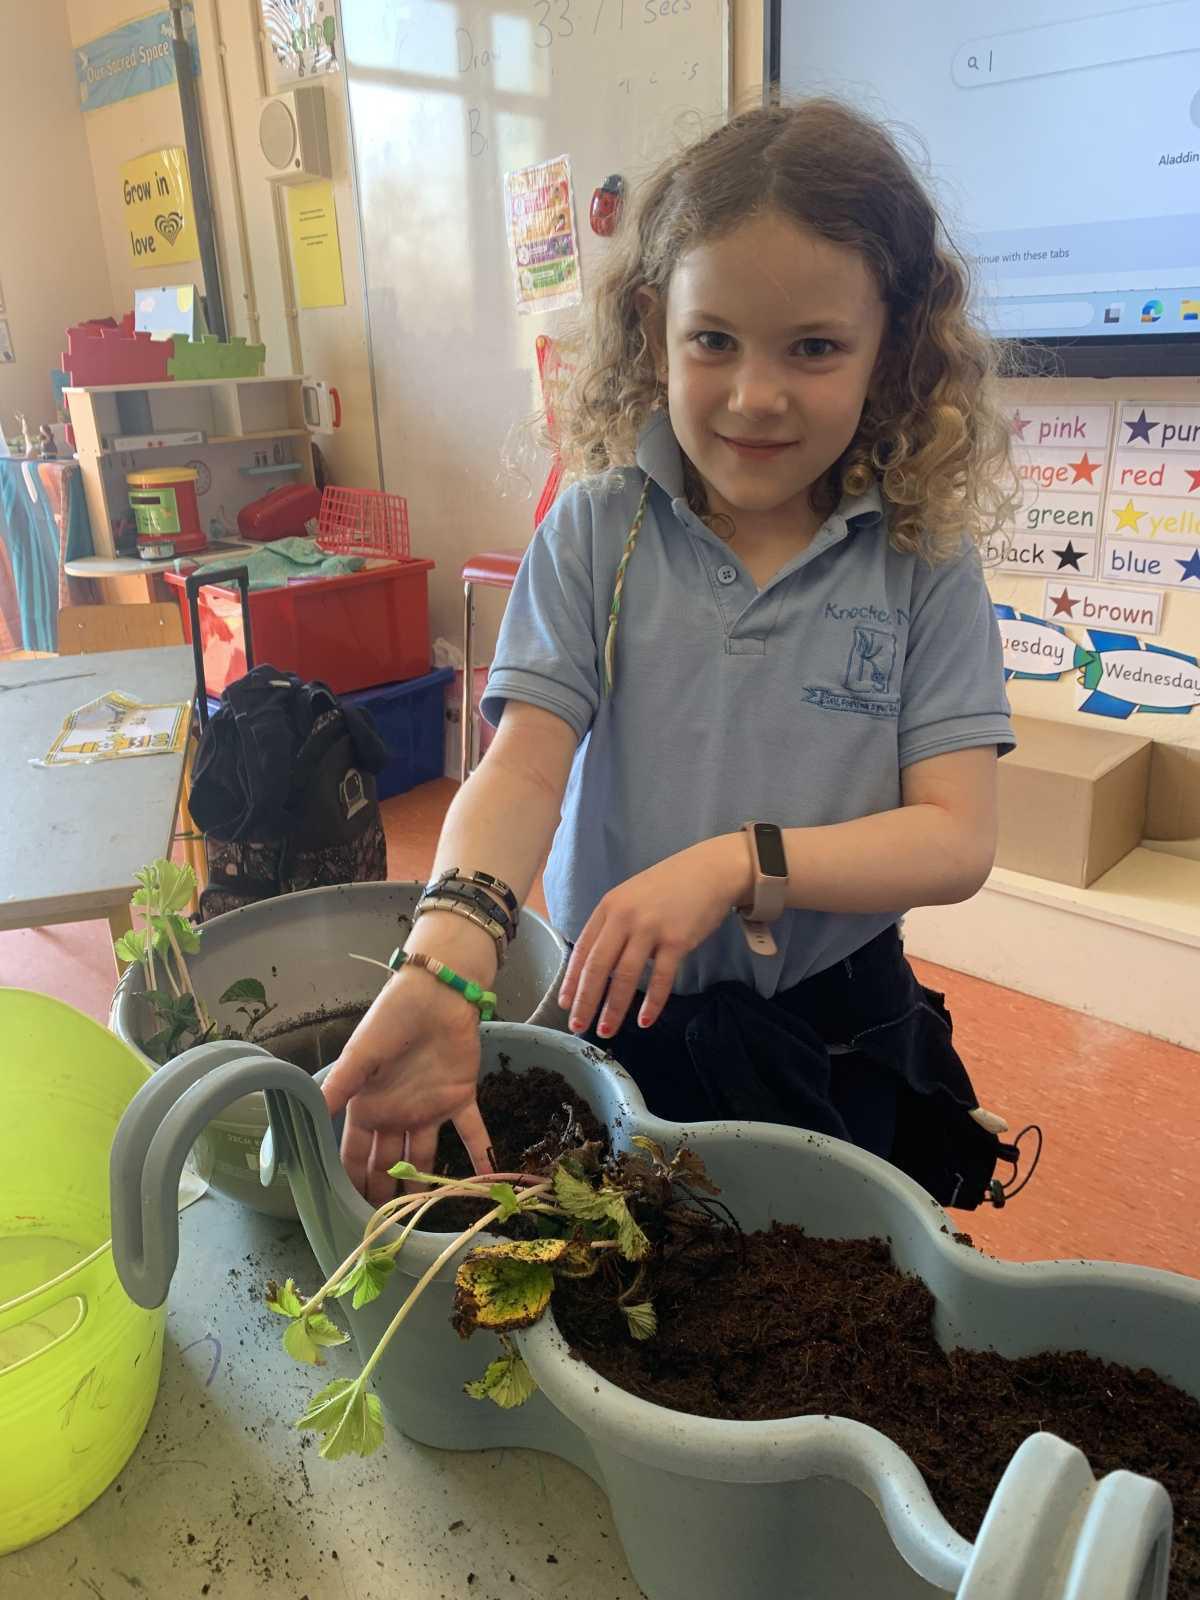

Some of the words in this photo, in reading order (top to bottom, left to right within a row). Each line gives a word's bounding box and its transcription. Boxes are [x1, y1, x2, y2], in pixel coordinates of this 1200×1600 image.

[139, 41, 169, 67] Space
[1158, 151, 1200, 166] Aladdin
[123, 179, 151, 205] Grow
[154, 170, 170, 196] in
[130, 231, 156, 256] love
[976, 253, 1000, 265] tinue
[1002, 250, 1020, 262] with
[1023, 249, 1048, 261] these
[1049, 248, 1070, 258] tabs
[1038, 415, 1088, 444] pink
[1161, 424, 1200, 448] pur
[1020, 465, 1068, 488] ange
[1120, 463, 1166, 487] red
[1027, 507, 1094, 530] green
[985, 540, 1045, 565] black
[1111, 549, 1162, 575] blue
[1082, 596, 1154, 626] brown
[1003, 636, 1065, 666] esday
[1105, 661, 1200, 698] Wednesday
